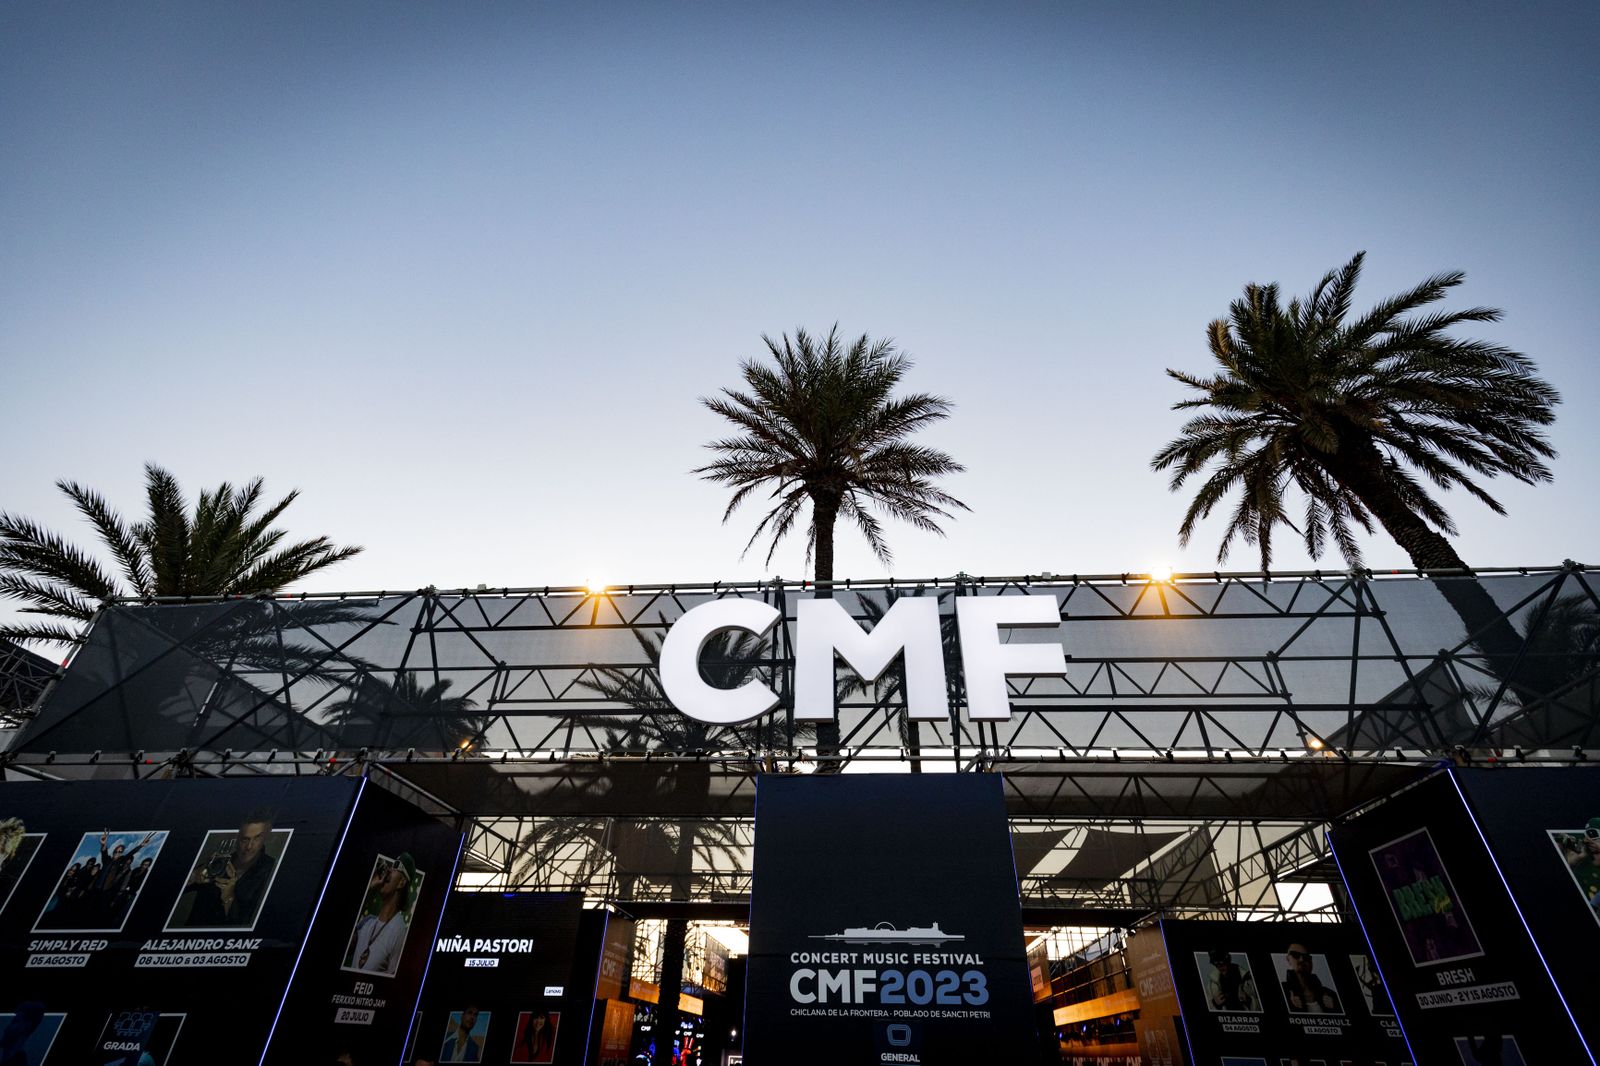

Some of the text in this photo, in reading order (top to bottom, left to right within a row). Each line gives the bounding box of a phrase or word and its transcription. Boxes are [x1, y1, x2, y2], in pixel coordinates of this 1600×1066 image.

[659, 595, 1067, 725] CMF
[27, 939, 109, 951] SIMPLY RED
[140, 938, 263, 951] ALEJANDRO SANZ
[435, 935, 534, 953] NIÑA PASTORI
[30, 954, 86, 966] 05 AGOSTO
[138, 954, 152, 966] 08
[152, 954, 183, 966] JULIO
[192, 954, 206, 965] 03
[206, 954, 247, 965] AGOSTO
[476, 959, 495, 967] JULIO
[790, 952, 984, 965] CONCERT MUSIC FESTIVAL
[1435, 967, 1476, 986] BRESH
[353, 981, 374, 996] FEID
[790, 968, 990, 1006] CMF2023
[1418, 995, 1430, 1007] 30
[1429, 993, 1453, 1006] JUNIO
[1458, 991, 1465, 1002] 2
[1465, 991, 1472, 1001] Y
[1472, 990, 1480, 1001] 15
[1481, 985, 1516, 999] AGOSTO
[340, 1010, 369, 1022] 20 JULIO
[790, 1008, 827, 1017] CHICLANA
[828, 1008, 838, 1017] DE
[839, 1009, 849, 1017] LA
[850, 1009, 889, 1017] FRONTERA
[893, 1009, 929, 1018] POBLADO
[930, 1009, 941, 1018] DE
[941, 1010, 968, 1018] SANCTI
[969, 1010, 991, 1019] PETRI
[1217, 1015, 1260, 1024] BIZARRAP
[1233, 1024, 1258, 1032] AGOSTO
[1289, 1017, 1352, 1027] ROBIN SCHULZ
[103, 1041, 141, 1051] GRADA
[880, 1053, 921, 1063] GENERAL
